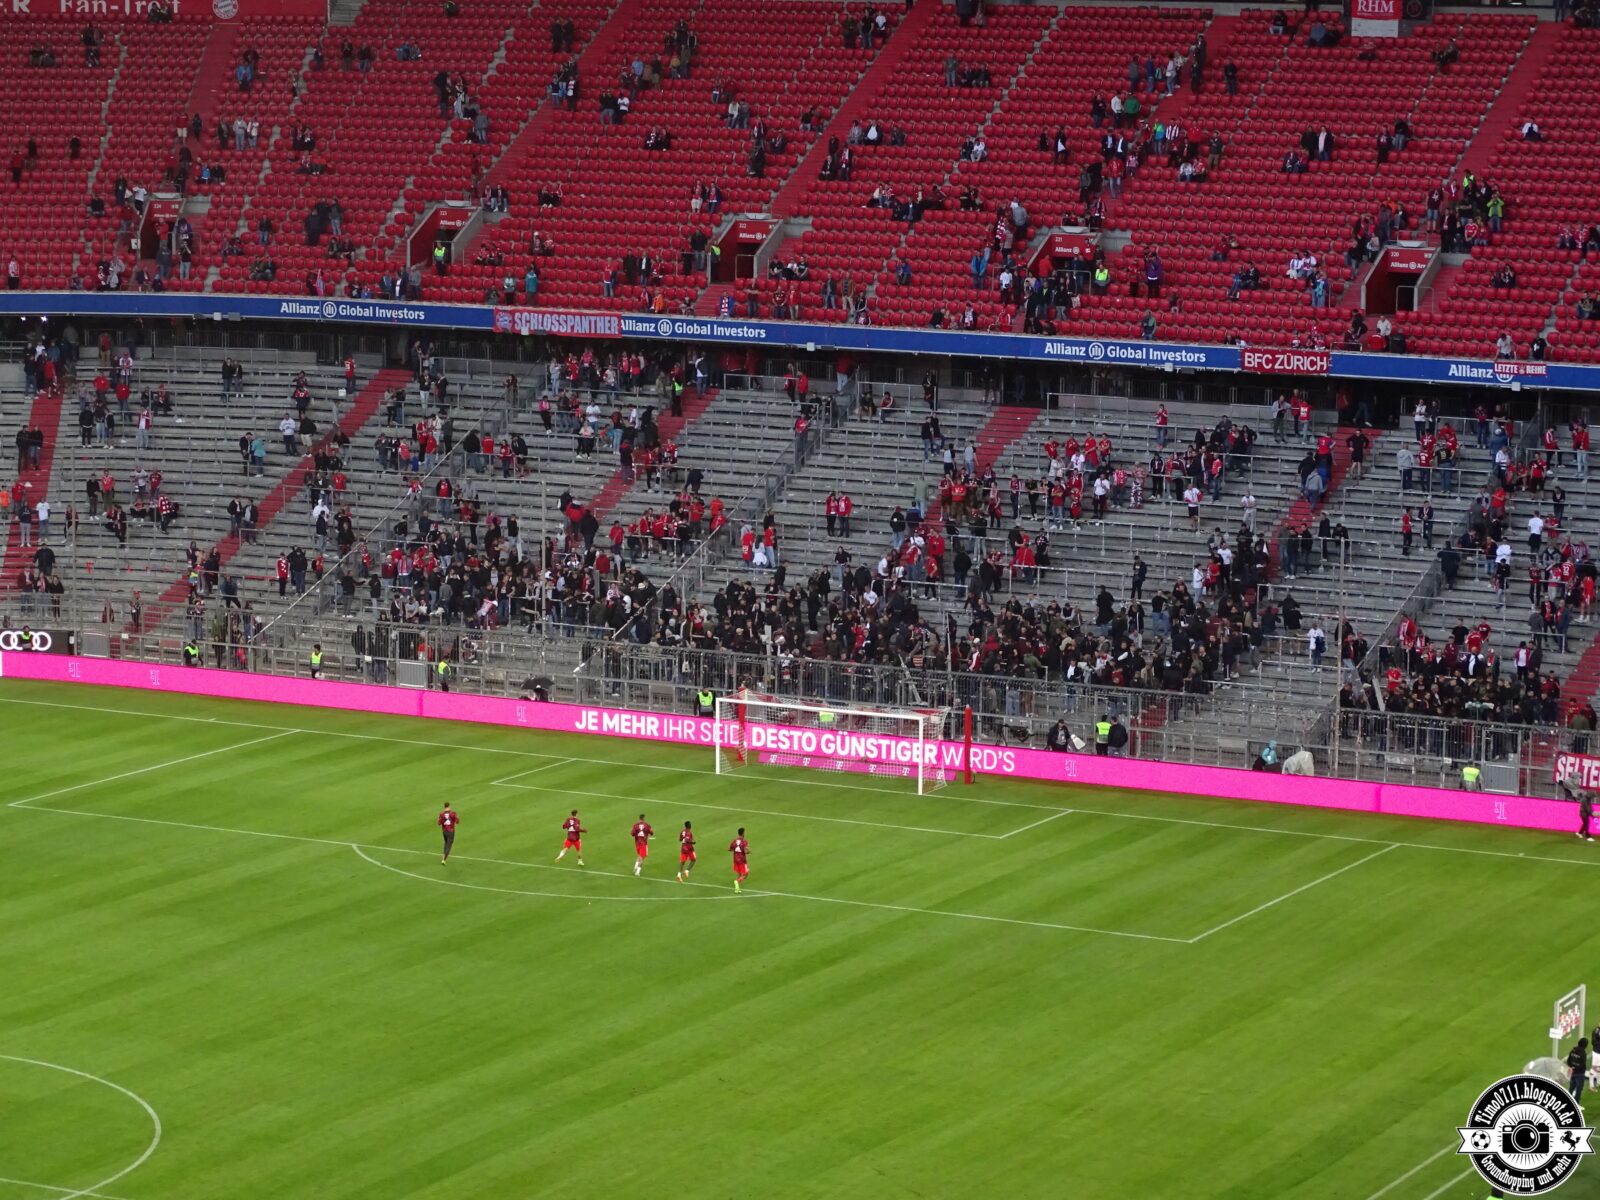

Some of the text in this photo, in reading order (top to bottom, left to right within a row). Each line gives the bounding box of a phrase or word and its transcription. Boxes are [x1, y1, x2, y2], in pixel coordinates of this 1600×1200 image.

[1357, 0, 1394, 12] RHM
[280, 302, 425, 320] Allianz Global Investors
[514, 312, 619, 335] SCHLOSSPANTHER
[621, 319, 766, 338] Allianz Global Investors
[1044, 342, 1206, 363] Allianz Global Investors
[1244, 352, 1327, 371] BFC ZÜRICH
[1448, 364, 1494, 379] Allianz
[1494, 363, 1546, 375] LETZTE REIHE
[575, 710, 598, 730] JE
[602, 713, 659, 737] MEHR
[663, 718, 696, 741] IHR
[751, 726, 817, 752] DESTO
[821, 730, 938, 765] GÜNSTIGER
[942, 745, 1015, 772] WRD'S
